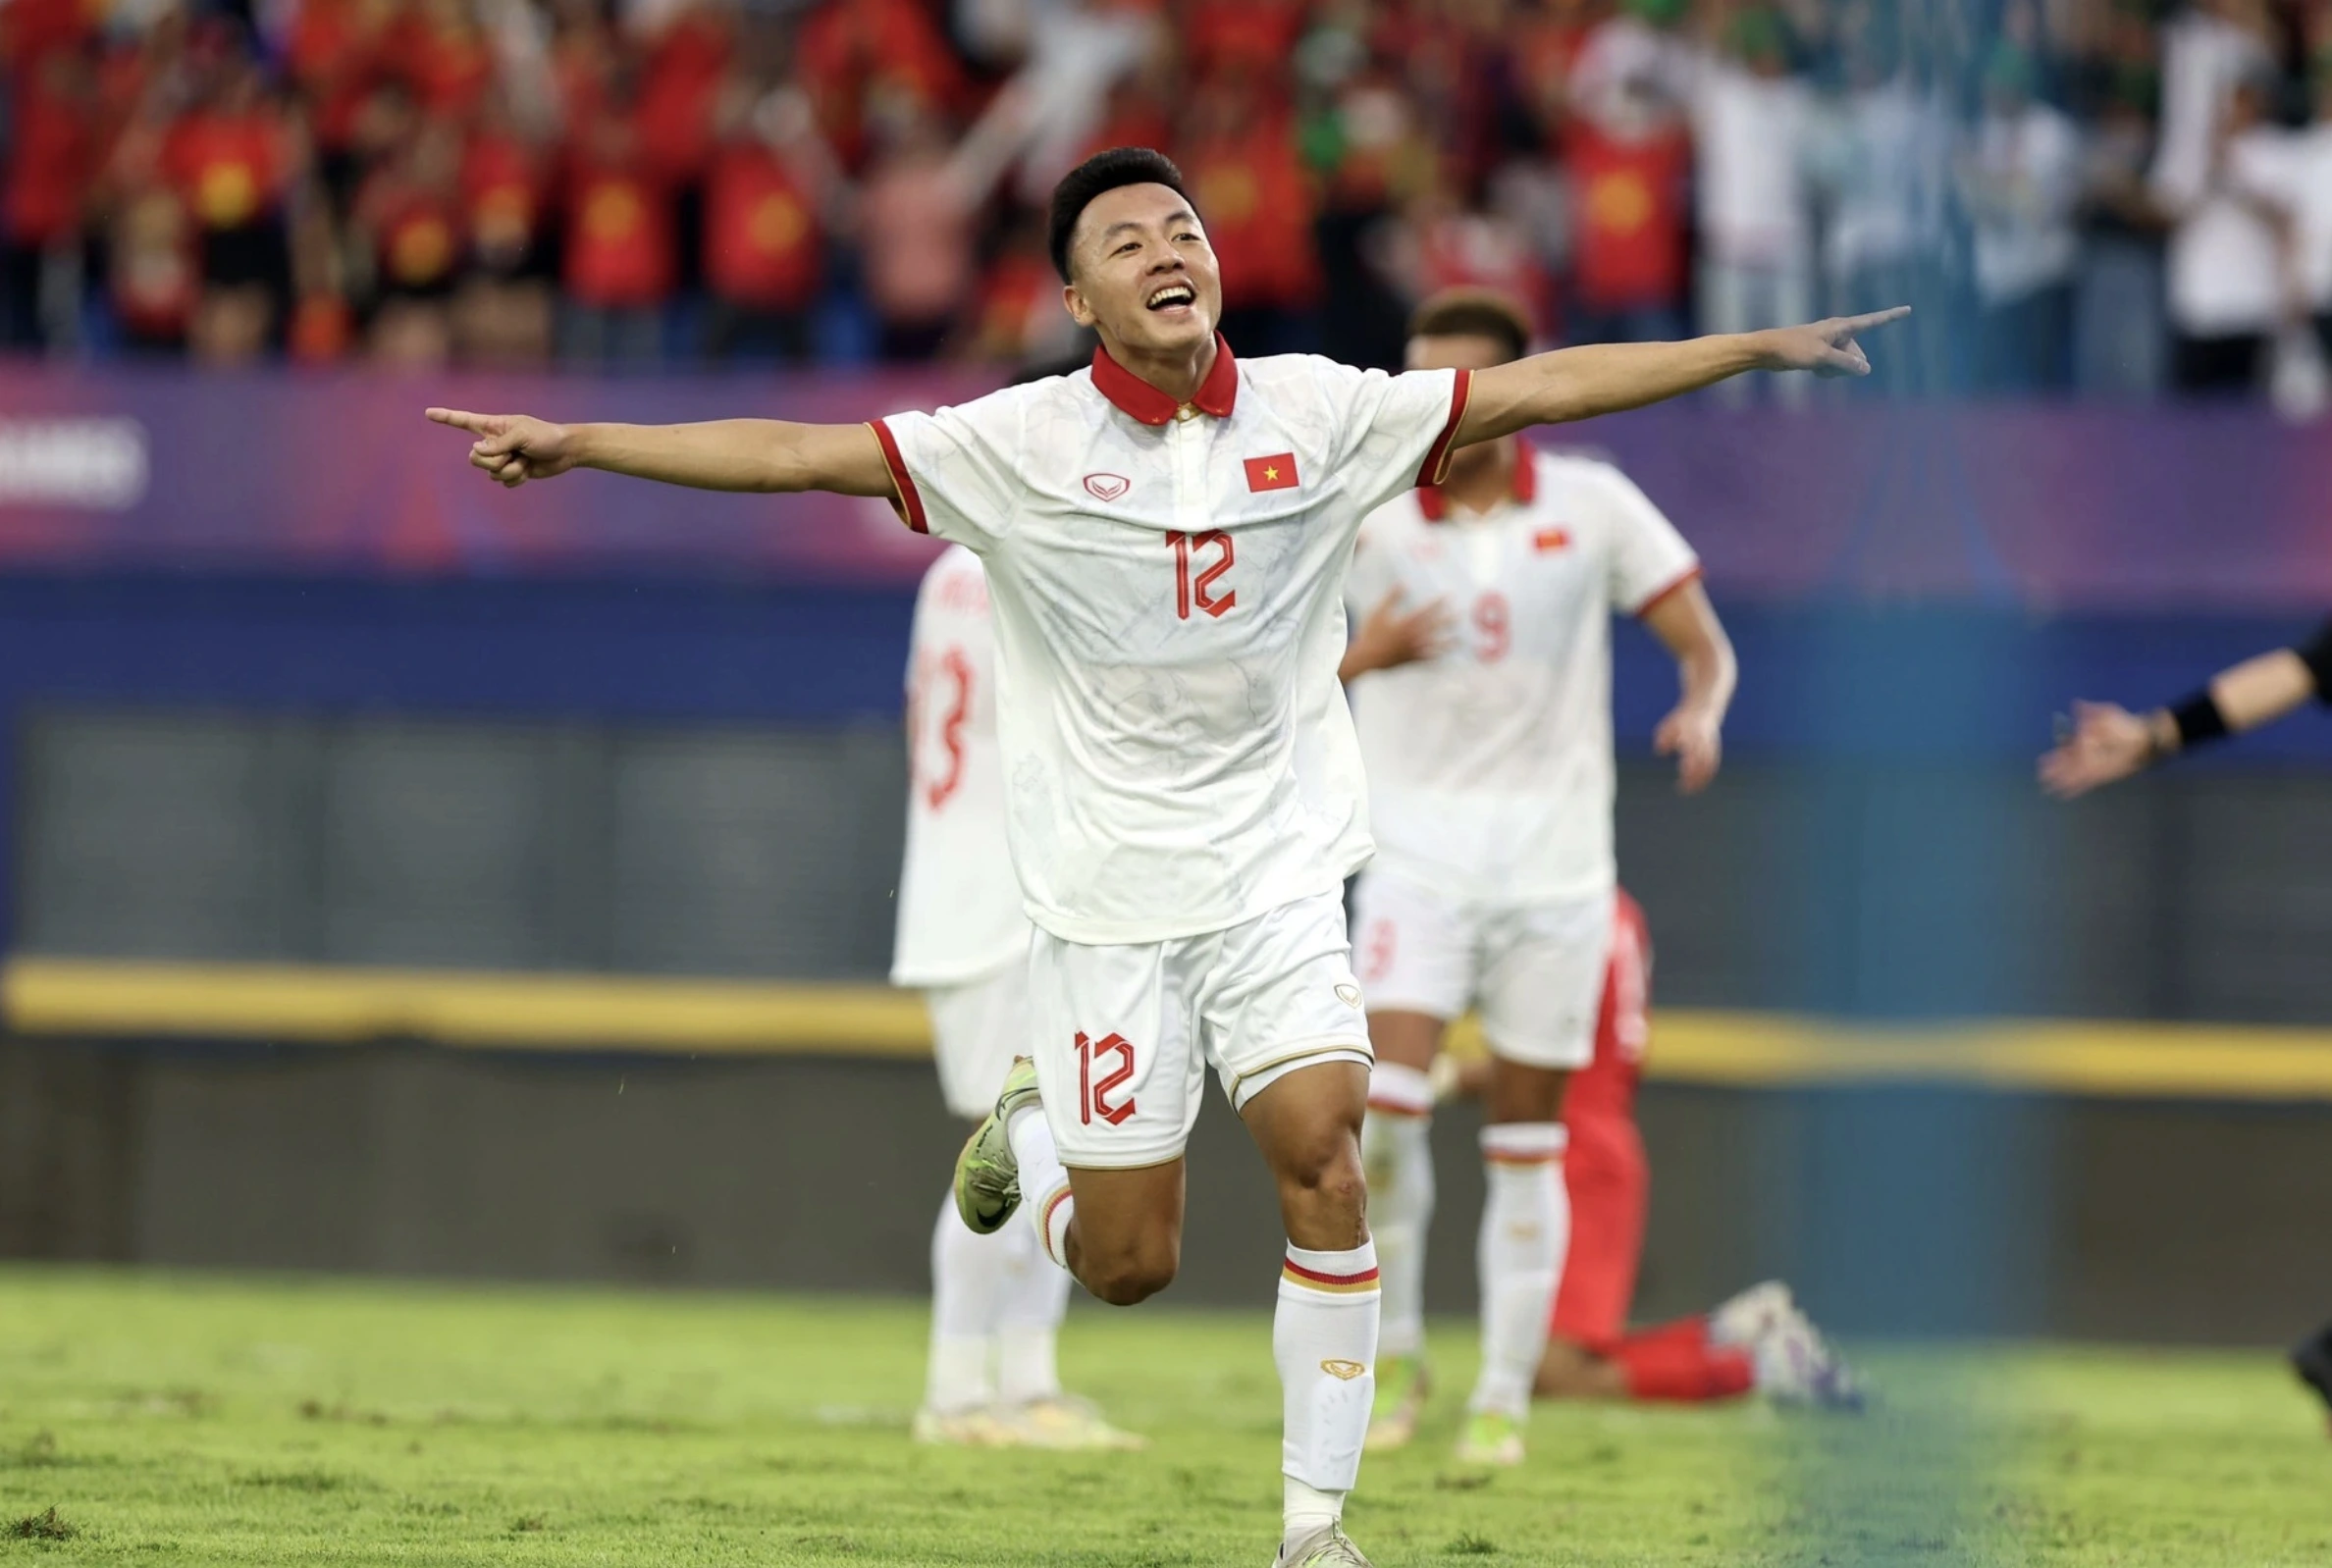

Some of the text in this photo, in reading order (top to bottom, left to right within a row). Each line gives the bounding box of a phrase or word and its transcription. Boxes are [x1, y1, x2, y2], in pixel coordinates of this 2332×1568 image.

[1165, 528, 1236, 620] 12
[1470, 591, 1512, 666] 9
[1074, 1030, 1136, 1126] 12
